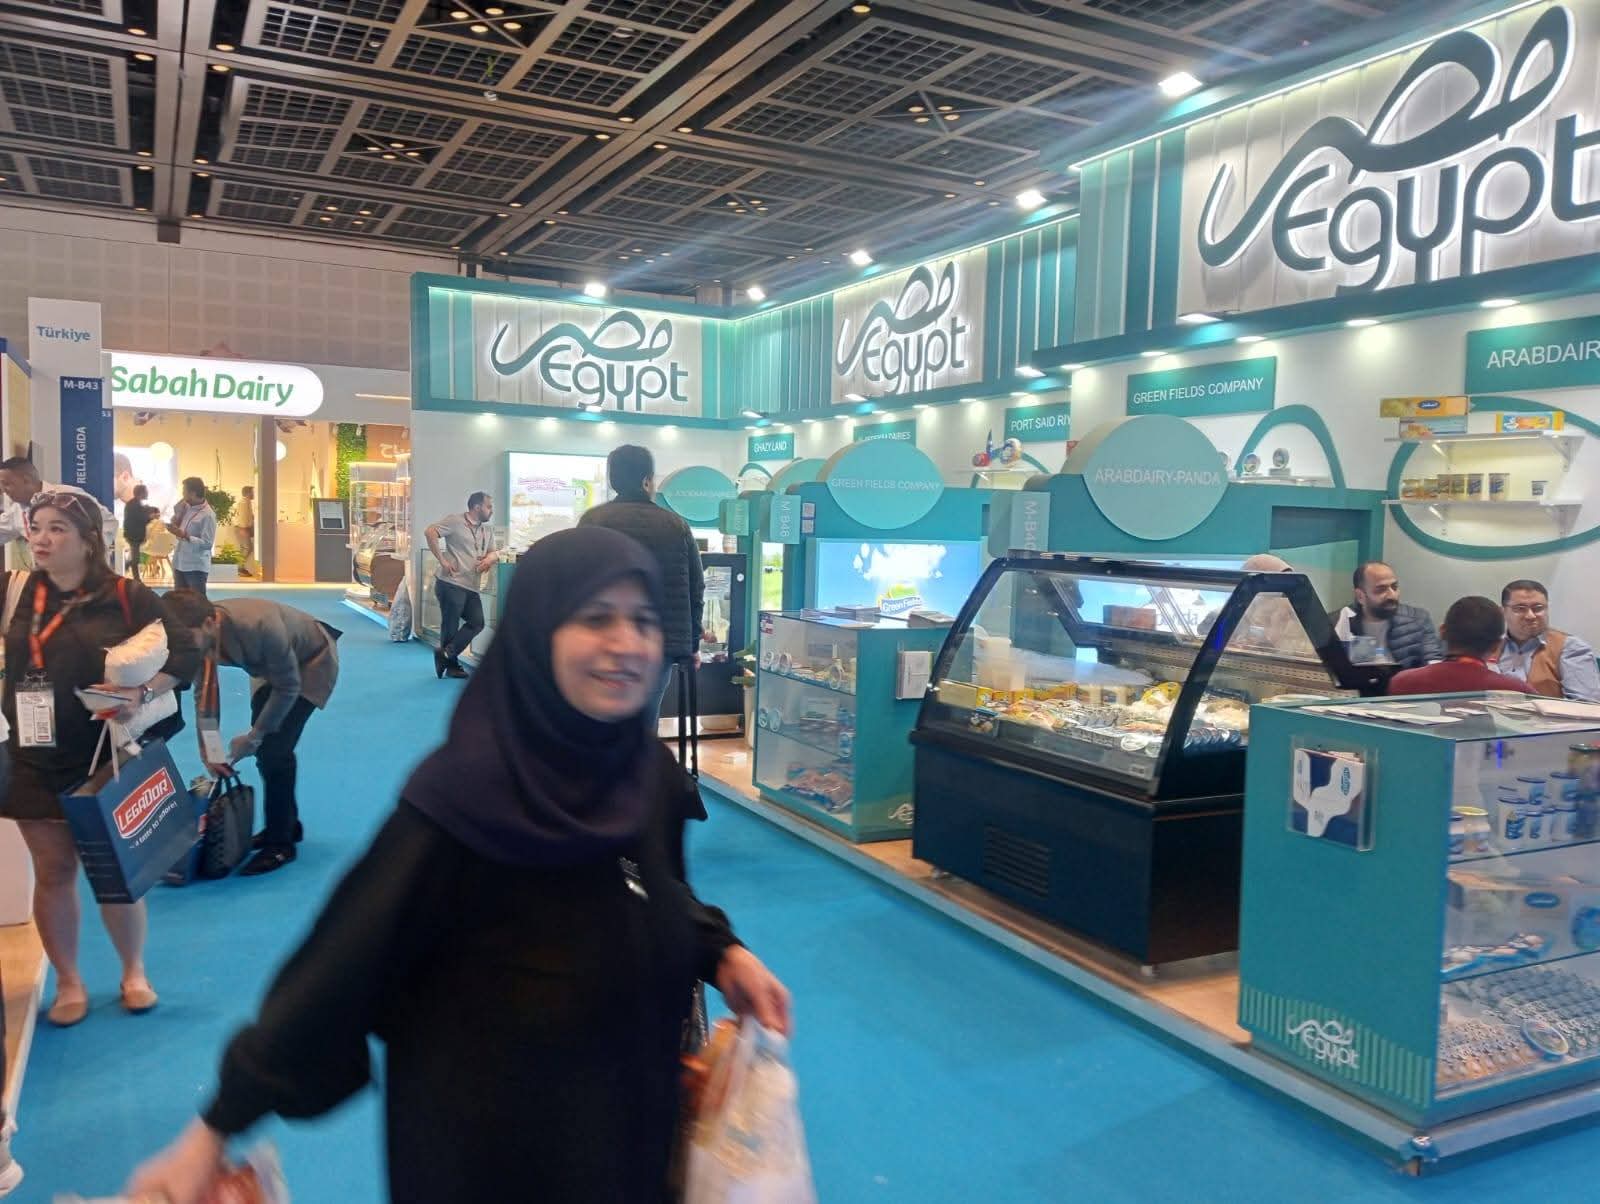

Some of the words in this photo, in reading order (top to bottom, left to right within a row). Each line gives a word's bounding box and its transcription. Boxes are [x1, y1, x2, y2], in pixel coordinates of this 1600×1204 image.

[1272, 114, 1600, 292] Egypt
[35, 325, 91, 342] Türkiye
[863, 316, 968, 393] Egypt
[1487, 340, 1600, 369] ARABDAIR
[63, 380, 99, 390] M-B43
[111, 365, 208, 398] Sabah
[213, 373, 294, 407] Dairy
[540, 344, 689, 411] Egypt
[1133, 391, 1167, 405] GREEN
[1168, 385, 1205, 400] FIELDS
[1207, 377, 1264, 395] COMPANY
[1011, 418, 1034, 431] PORT
[1035, 416, 1056, 429] SAID
[76, 426, 87, 453] GIDA
[76, 454, 87, 484] RELLA
[831, 478, 862, 489] GREEN
[865, 479, 896, 489] FIELDS
[897, 480, 940, 490] COMPANY
[1302, 1028, 1359, 1069] Egypt
